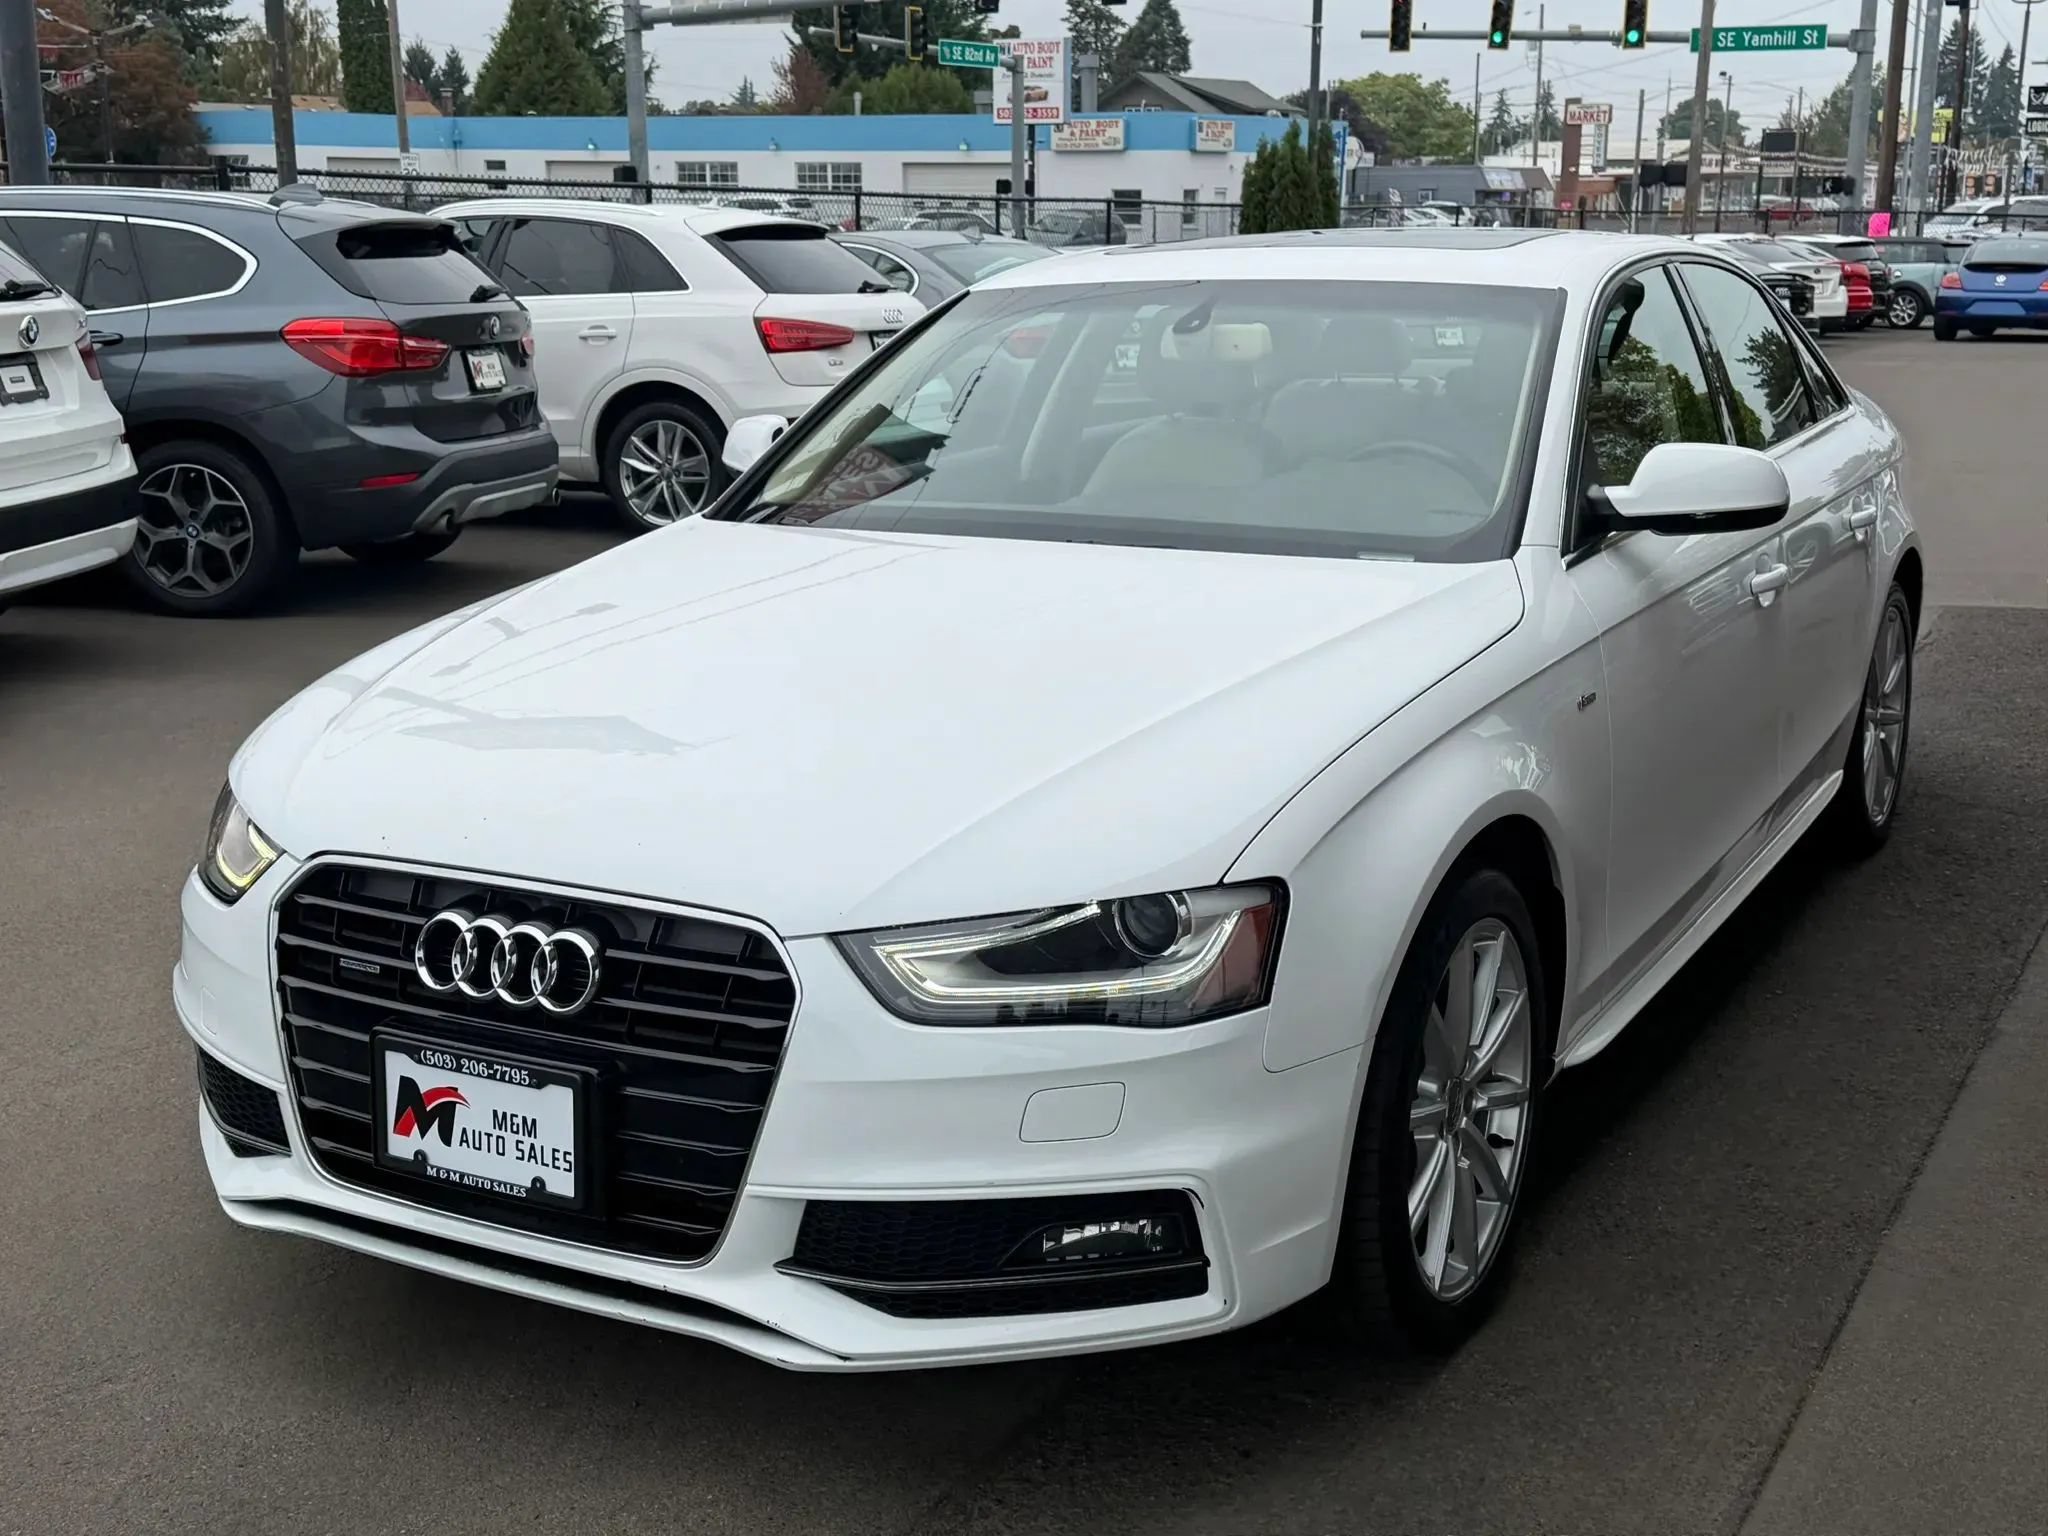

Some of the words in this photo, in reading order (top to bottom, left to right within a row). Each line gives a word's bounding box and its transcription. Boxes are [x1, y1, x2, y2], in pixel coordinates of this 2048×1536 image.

[1717, 31, 1736, 47] SE
[1743, 30, 1796, 46] Yamhill
[1802, 29, 1818, 45] St
[952, 46, 962, 60] SE
[965, 47, 983, 62] 82nd
[985, 51, 995, 63] Av
[1013, 42, 1034, 55] AUTO
[1037, 42, 1061, 54] BODY
[1027, 56, 1054, 69] PAINT
[1096, 120, 1120, 129] BODY
[1569, 111, 1608, 122] MARKET
[1079, 129, 1107, 137] PAINT
[420, 1049, 456, 1070] (503)
[460, 1058, 529, 1085] 206-7795
[492, 1109, 537, 1139] M&M
[459, 1127, 506, 1157] AUTO
[515, 1140, 572, 1173] SALES
[426, 1165, 437, 1177] M
[439, 1169, 448, 1179] &
[449, 1171, 460, 1183] M
[462, 1174, 491, 1190] AUTO
[493, 1181, 527, 1198] SALES
